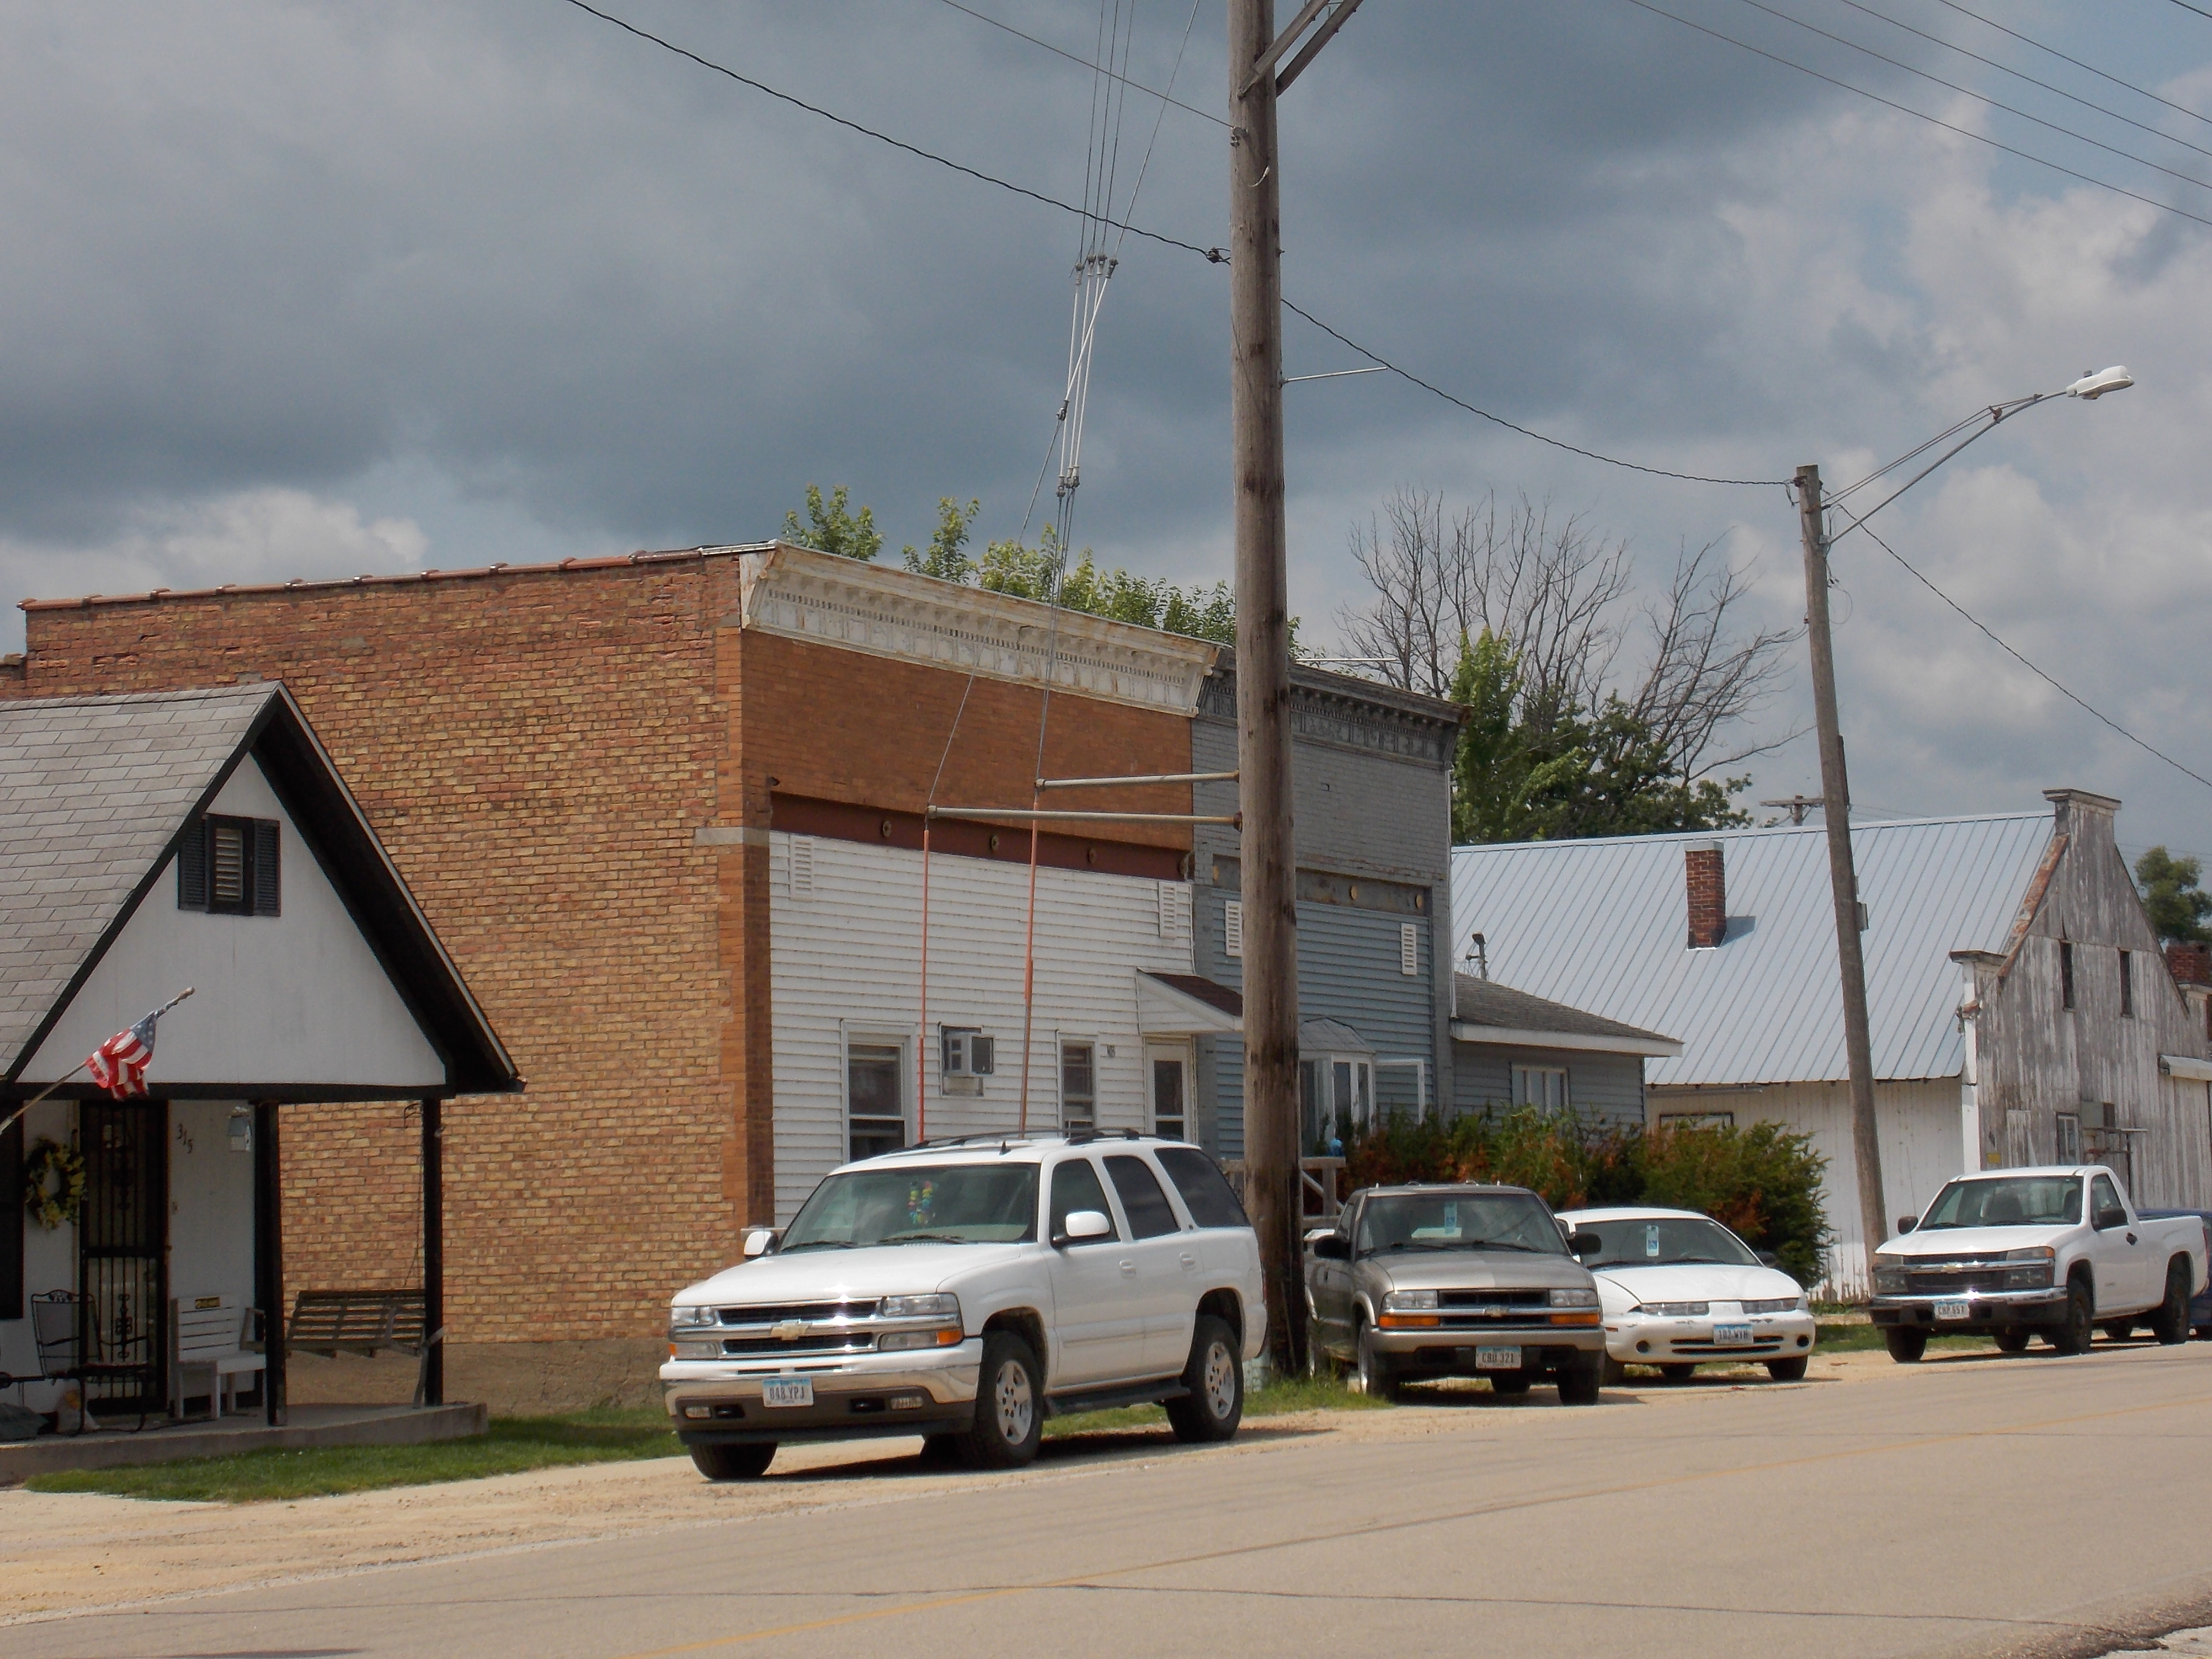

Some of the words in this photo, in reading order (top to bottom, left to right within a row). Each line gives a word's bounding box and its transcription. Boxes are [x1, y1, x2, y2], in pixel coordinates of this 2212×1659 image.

[176, 1123, 193, 1154] 315
[1500, 1353, 1513, 1363] 321
[788, 1385, 805, 1399] YPJ
